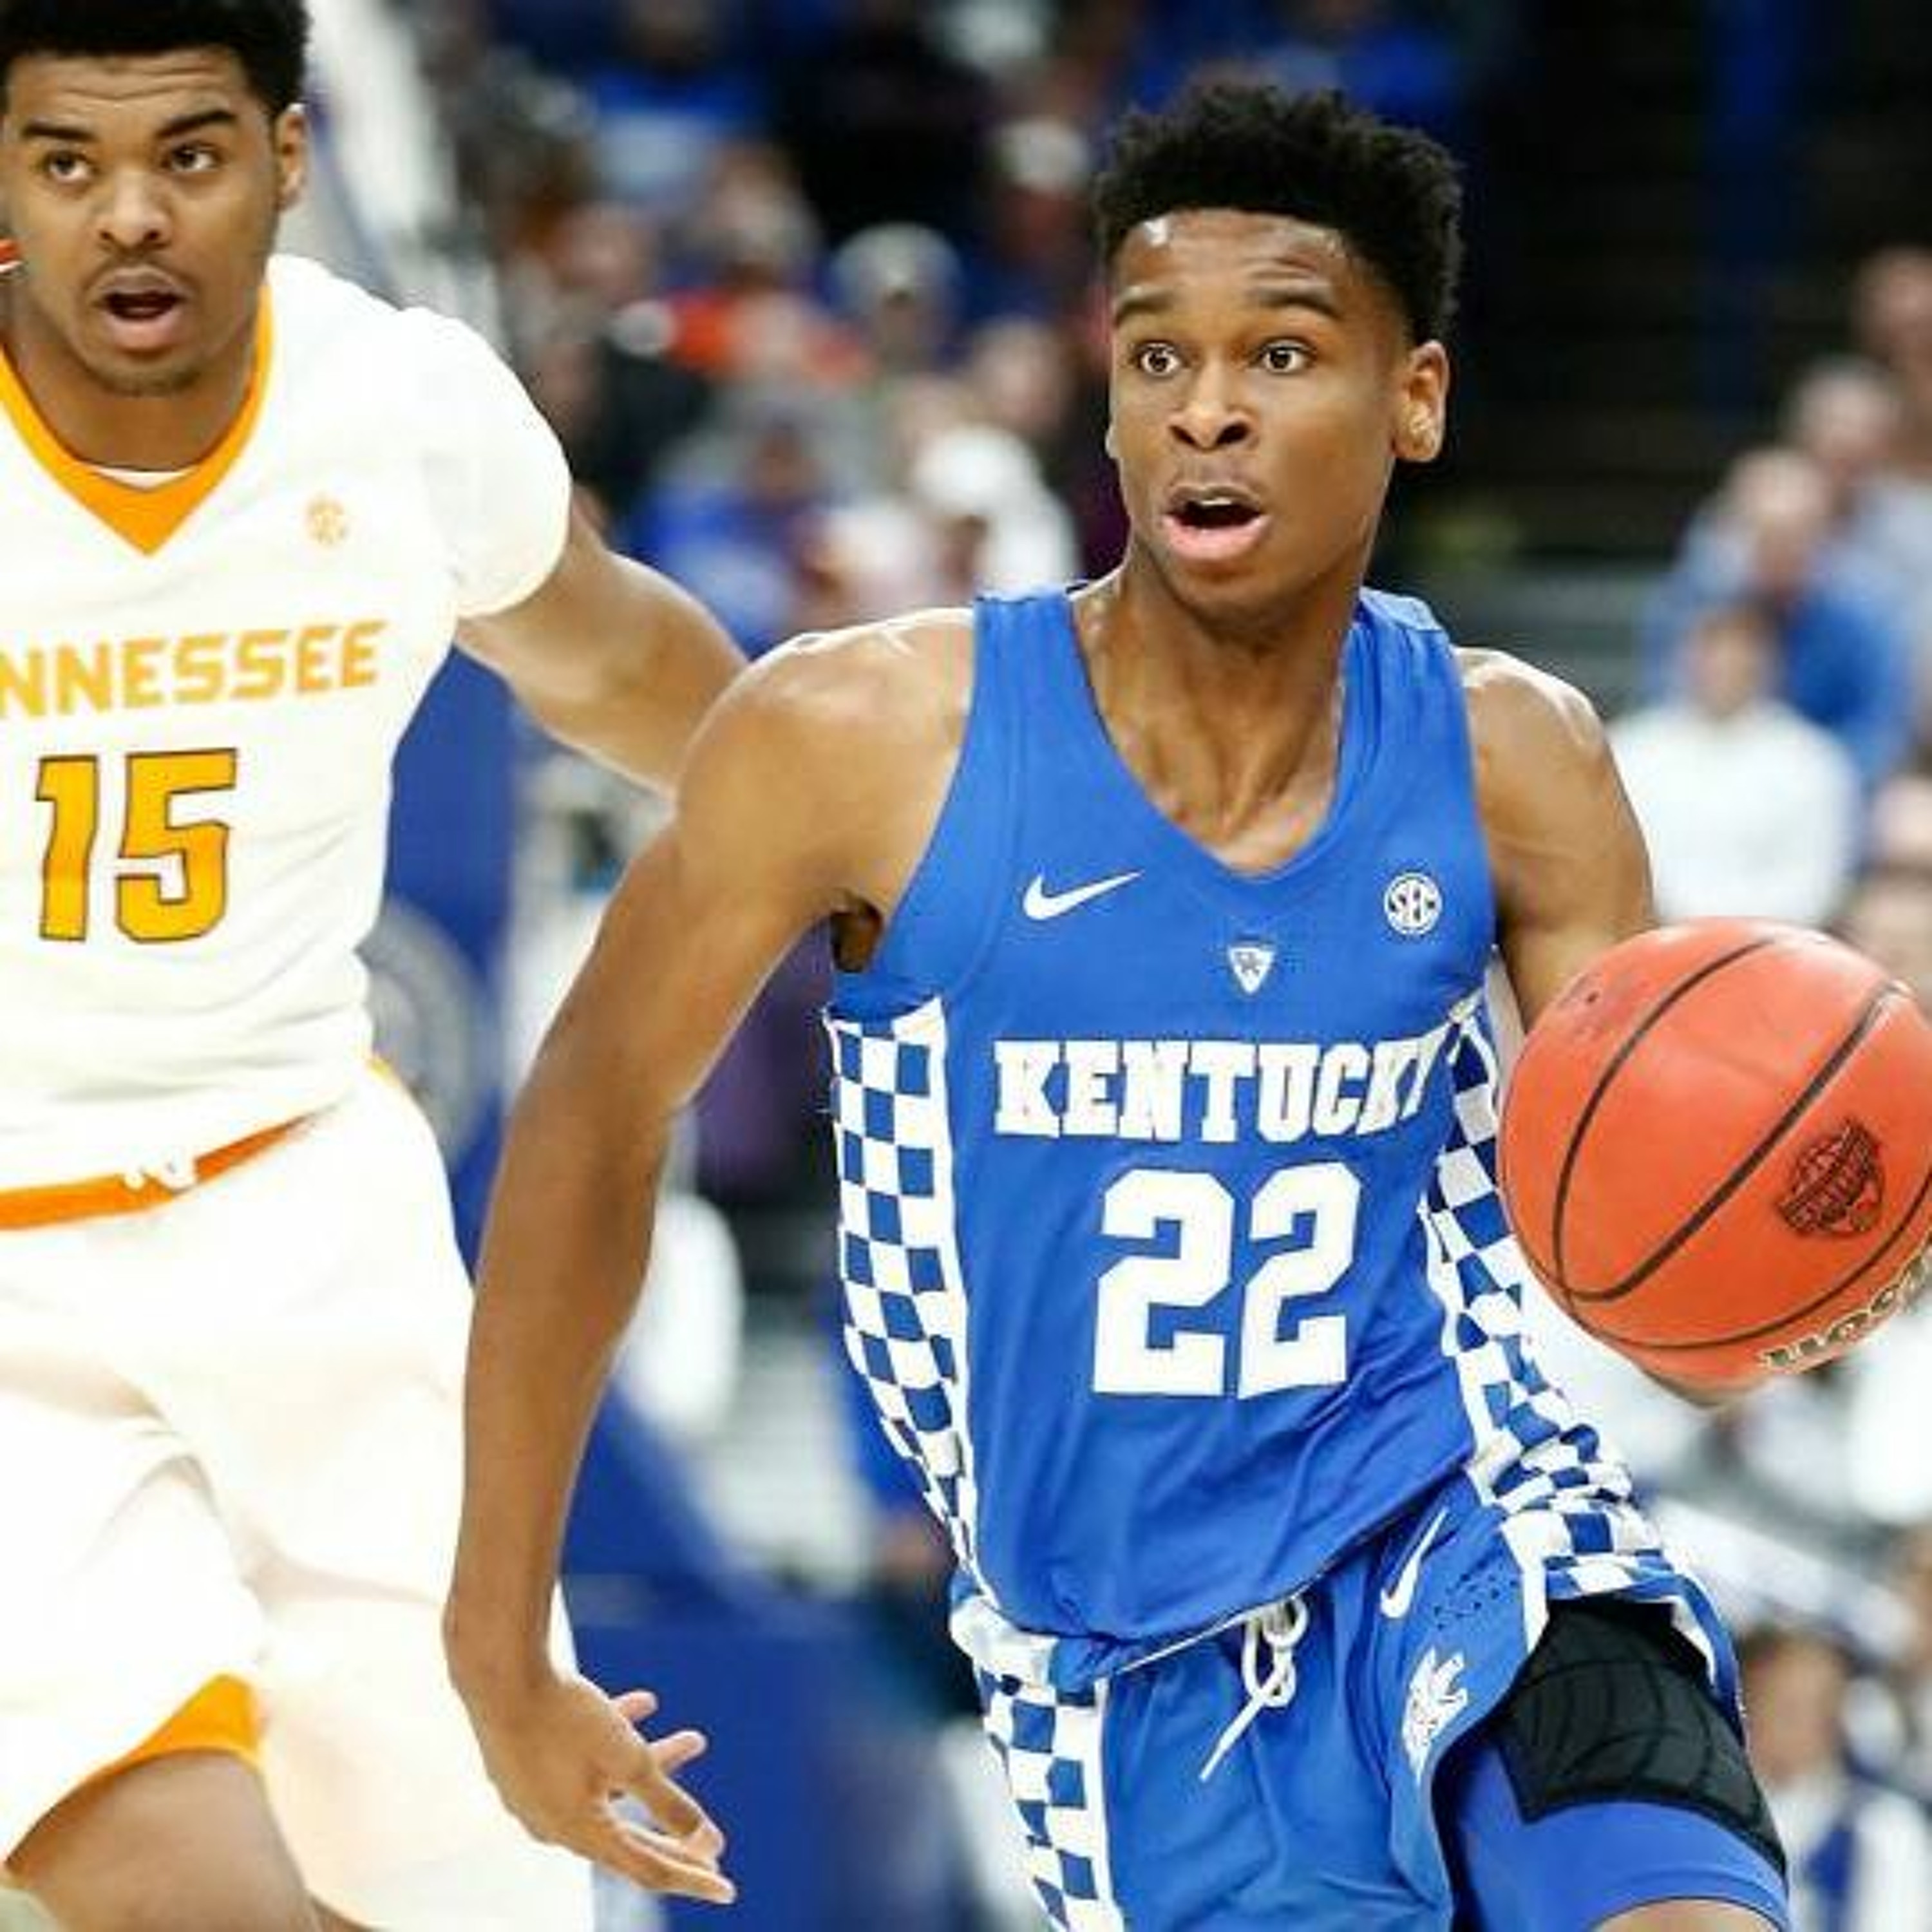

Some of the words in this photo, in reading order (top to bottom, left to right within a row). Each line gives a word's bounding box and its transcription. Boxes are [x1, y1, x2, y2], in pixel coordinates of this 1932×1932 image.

[0, 620, 385, 717] NNESSEE
[33, 747, 238, 945] 15
[1094, 1163, 1360, 1398] 22
